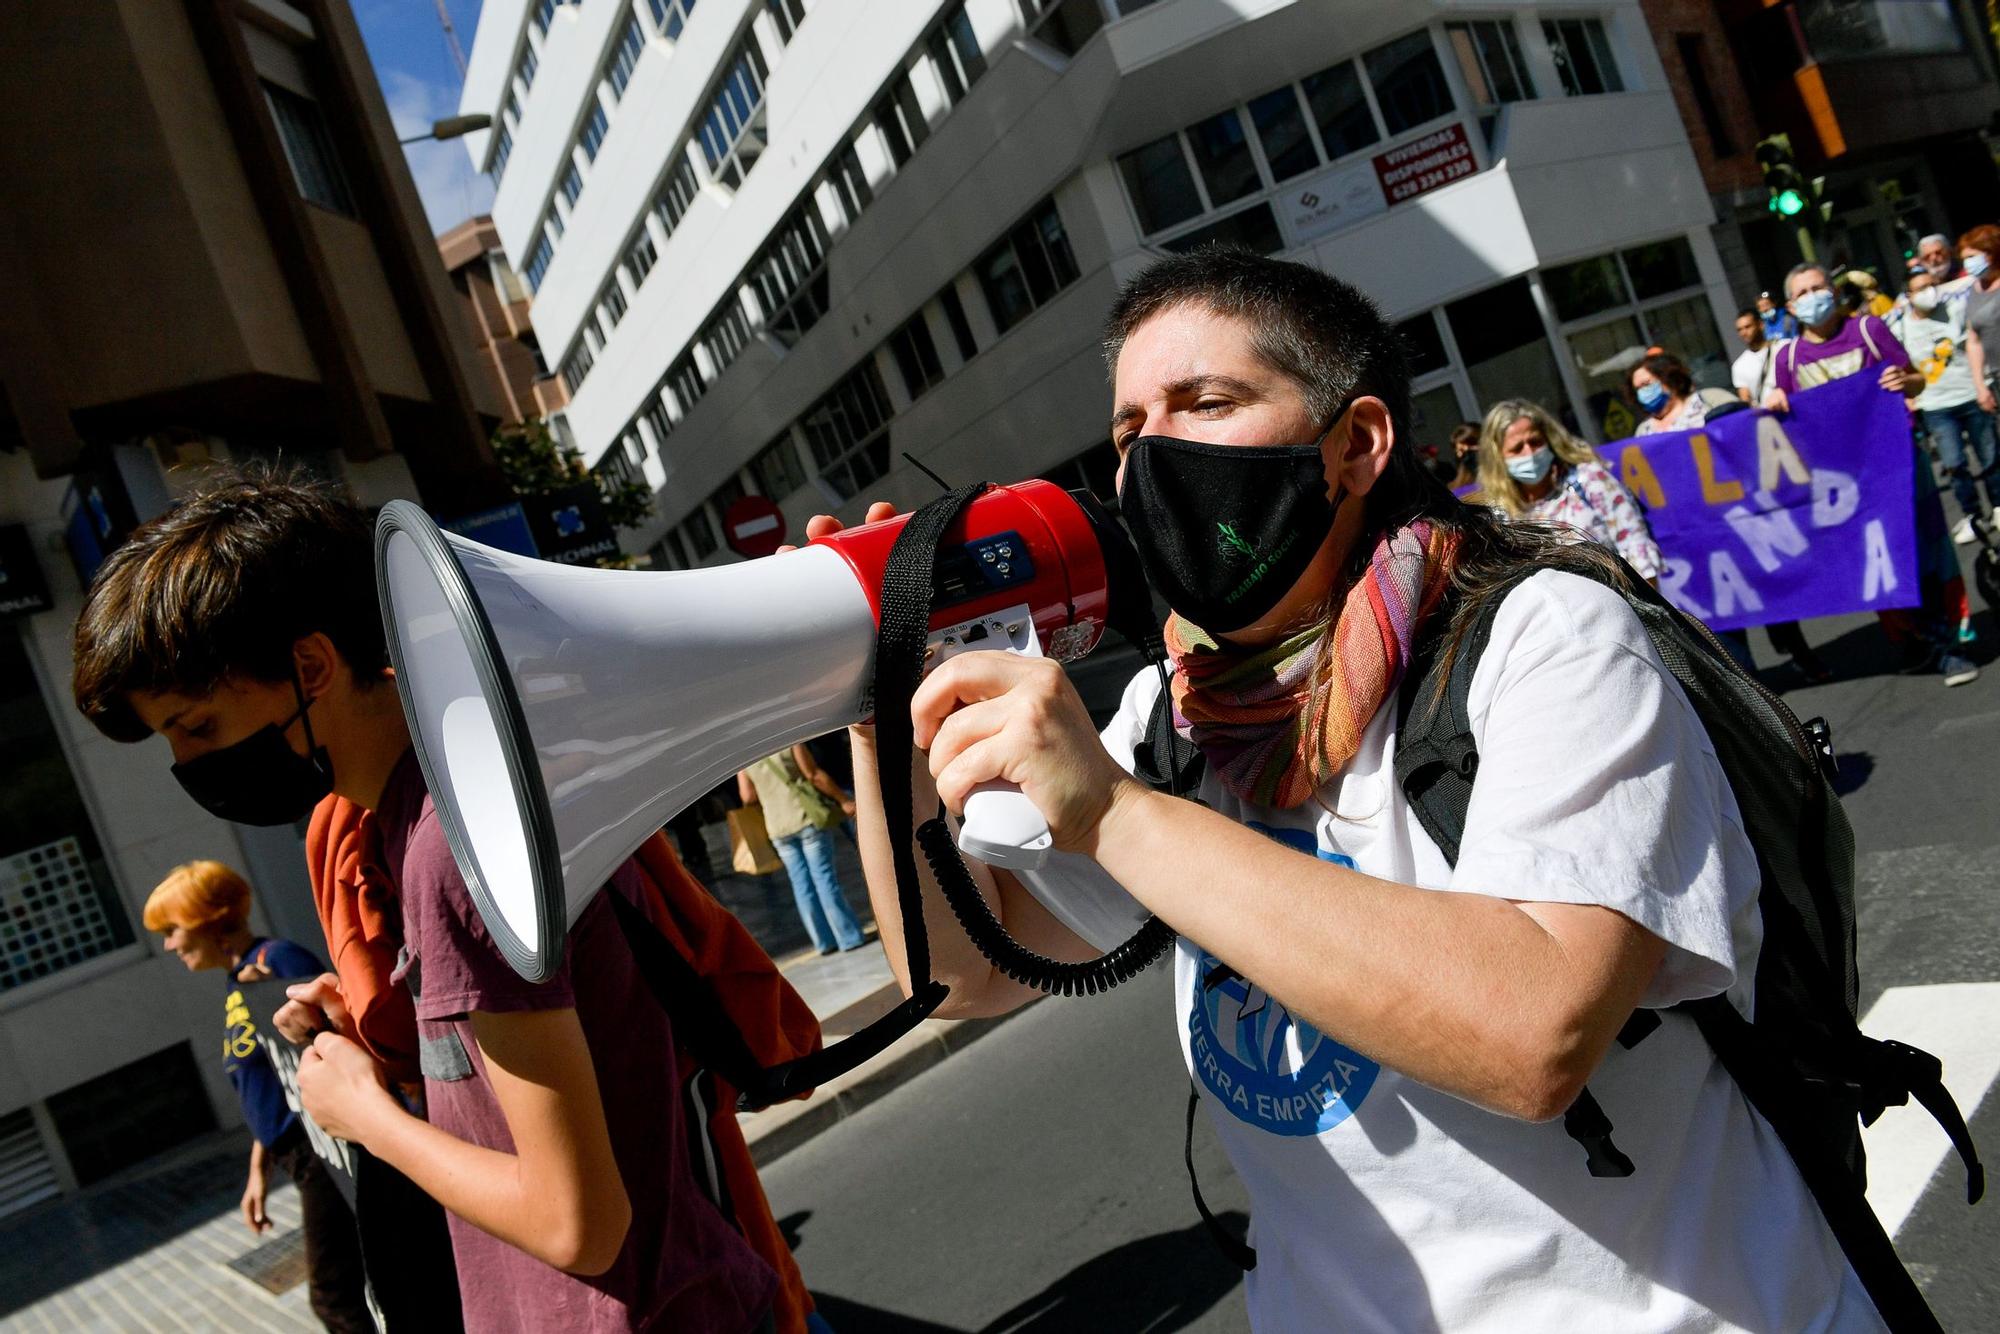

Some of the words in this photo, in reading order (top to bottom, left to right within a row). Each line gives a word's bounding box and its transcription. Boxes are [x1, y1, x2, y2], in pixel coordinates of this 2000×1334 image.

[1383, 144, 1469, 186] DISPONIBLES
[1386, 129, 1455, 165] VIVIENDAS
[1226, 562, 1268, 605] TRABAJO
[980, 616, 994, 626] MIC
[1256, 1058, 1360, 1122] EMPIEZA
